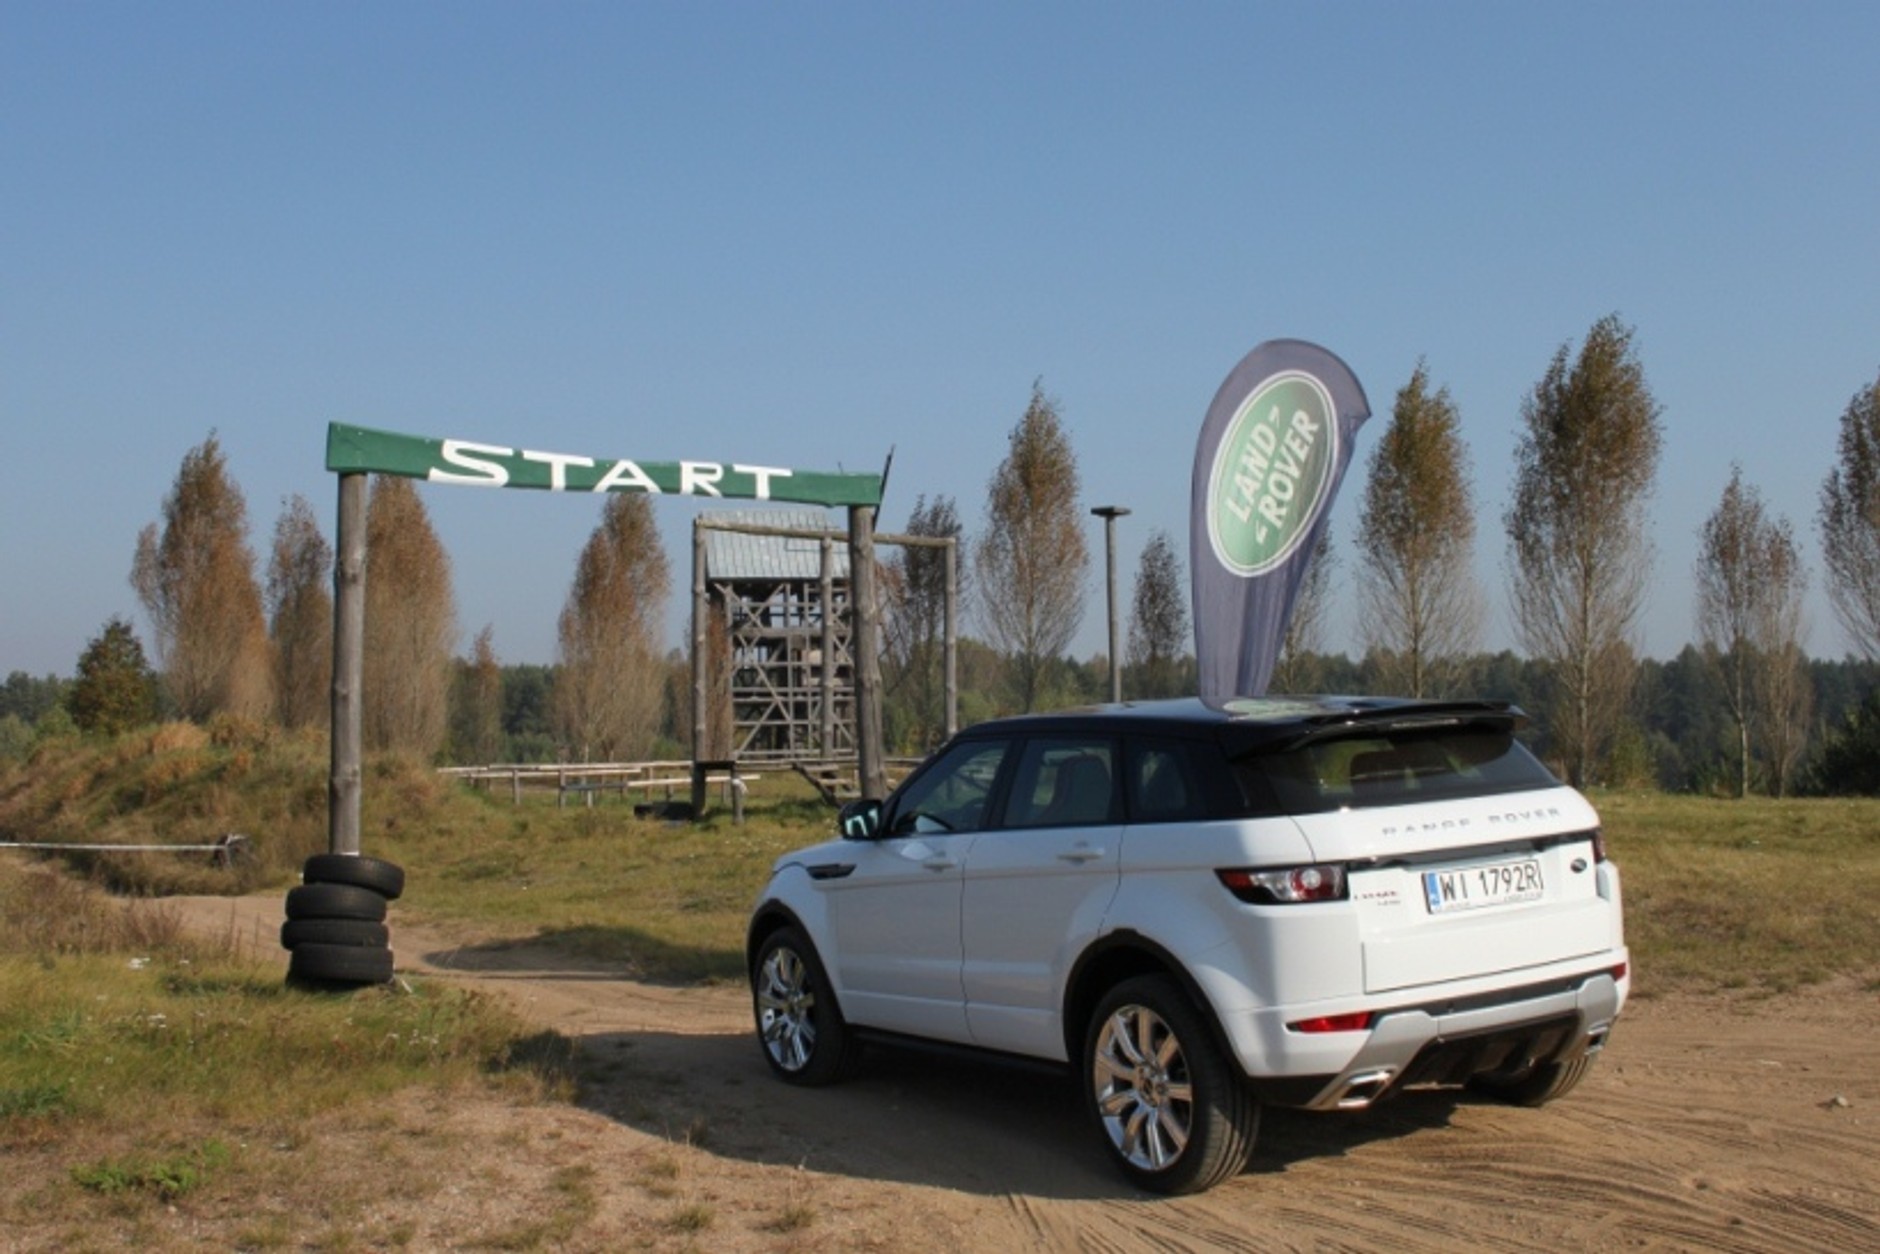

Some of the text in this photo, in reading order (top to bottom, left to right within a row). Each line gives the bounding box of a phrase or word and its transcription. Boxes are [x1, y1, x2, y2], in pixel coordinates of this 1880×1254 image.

[427, 438, 793, 500] START
[1225, 421, 1278, 522] LAND
[1258, 410, 1319, 528] ROVER
[1488, 807, 1560, 823] ROVER
[1439, 864, 1538, 902] WI 1792R
